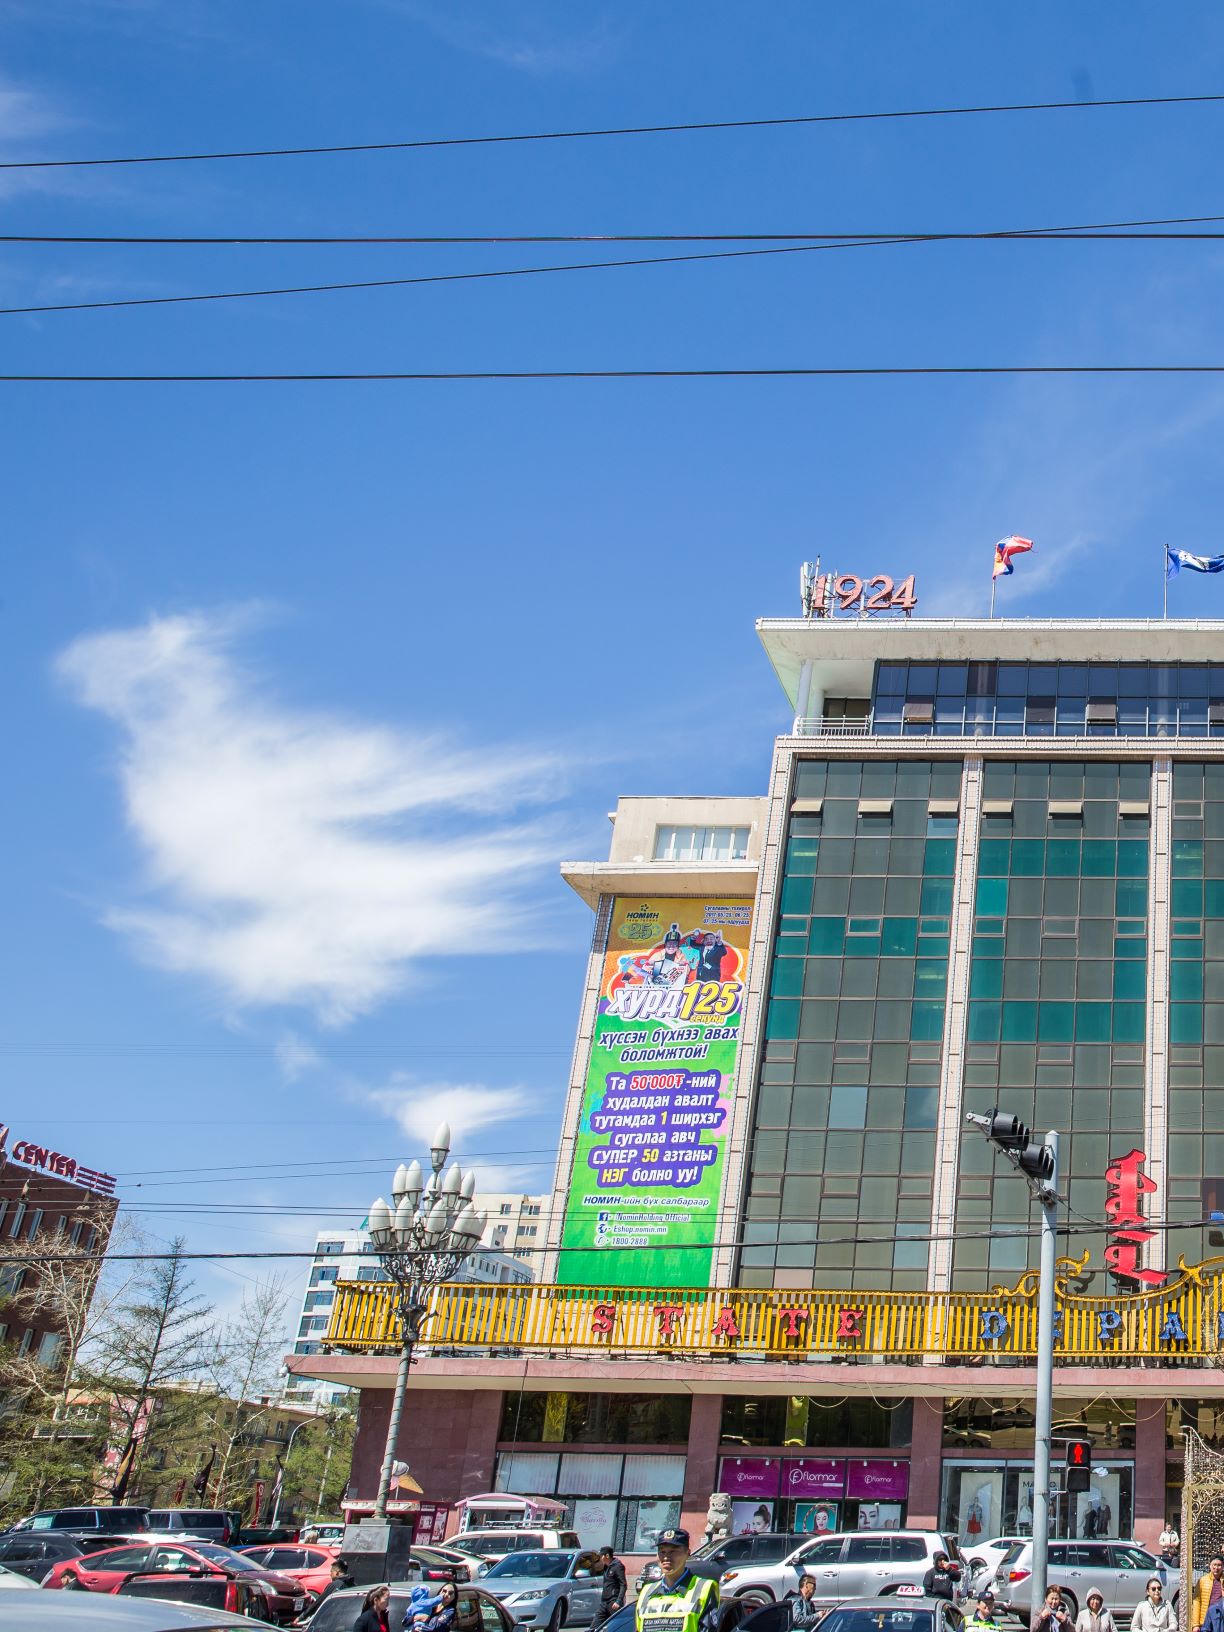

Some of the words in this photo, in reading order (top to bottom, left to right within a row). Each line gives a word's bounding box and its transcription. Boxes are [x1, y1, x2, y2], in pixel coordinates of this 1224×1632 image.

[812, 574, 917, 611] 1924
[626, 911, 659, 919] НОМИН
[608, 989, 682, 1019] ХУРД
[679, 981, 742, 1020] 125
[690, 1014, 726, 1024] секунд
[600, 1031, 648, 1049] хүссэн
[651, 1028, 700, 1047] бүхнээ
[704, 1027, 739, 1040] авах
[620, 1044, 708, 1062] боломжтой!
[610, 1076, 627, 1091] Та
[606, 1094, 670, 1110] худалдан
[673, 1093, 715, 1107] авалт
[594, 1113, 656, 1129] тутамдаа
[660, 1111, 667, 1125] 1
[671, 1111, 722, 1128] ширхэг
[614, 1132, 666, 1147] сугалаа
[671, 1131, 696, 1143] авч
[12, 1140, 77, 1179] CENTER
[592, 1150, 638, 1165] СУПЕР
[641, 1148, 660, 1163] 50
[662, 1148, 713, 1162] азтаны
[601, 1168, 628, 1183] НЭГ
[631, 1167, 673, 1182] болно
[677, 1166, 698, 1183] уу!
[583, 1196, 641, 1204] НОМИН-ийн
[643, 1196, 658, 1206] бүх
[661, 1198, 710, 1207] салбараар
[591, 1304, 864, 1337] STATE
[803, 1470, 838, 1482] flormar
